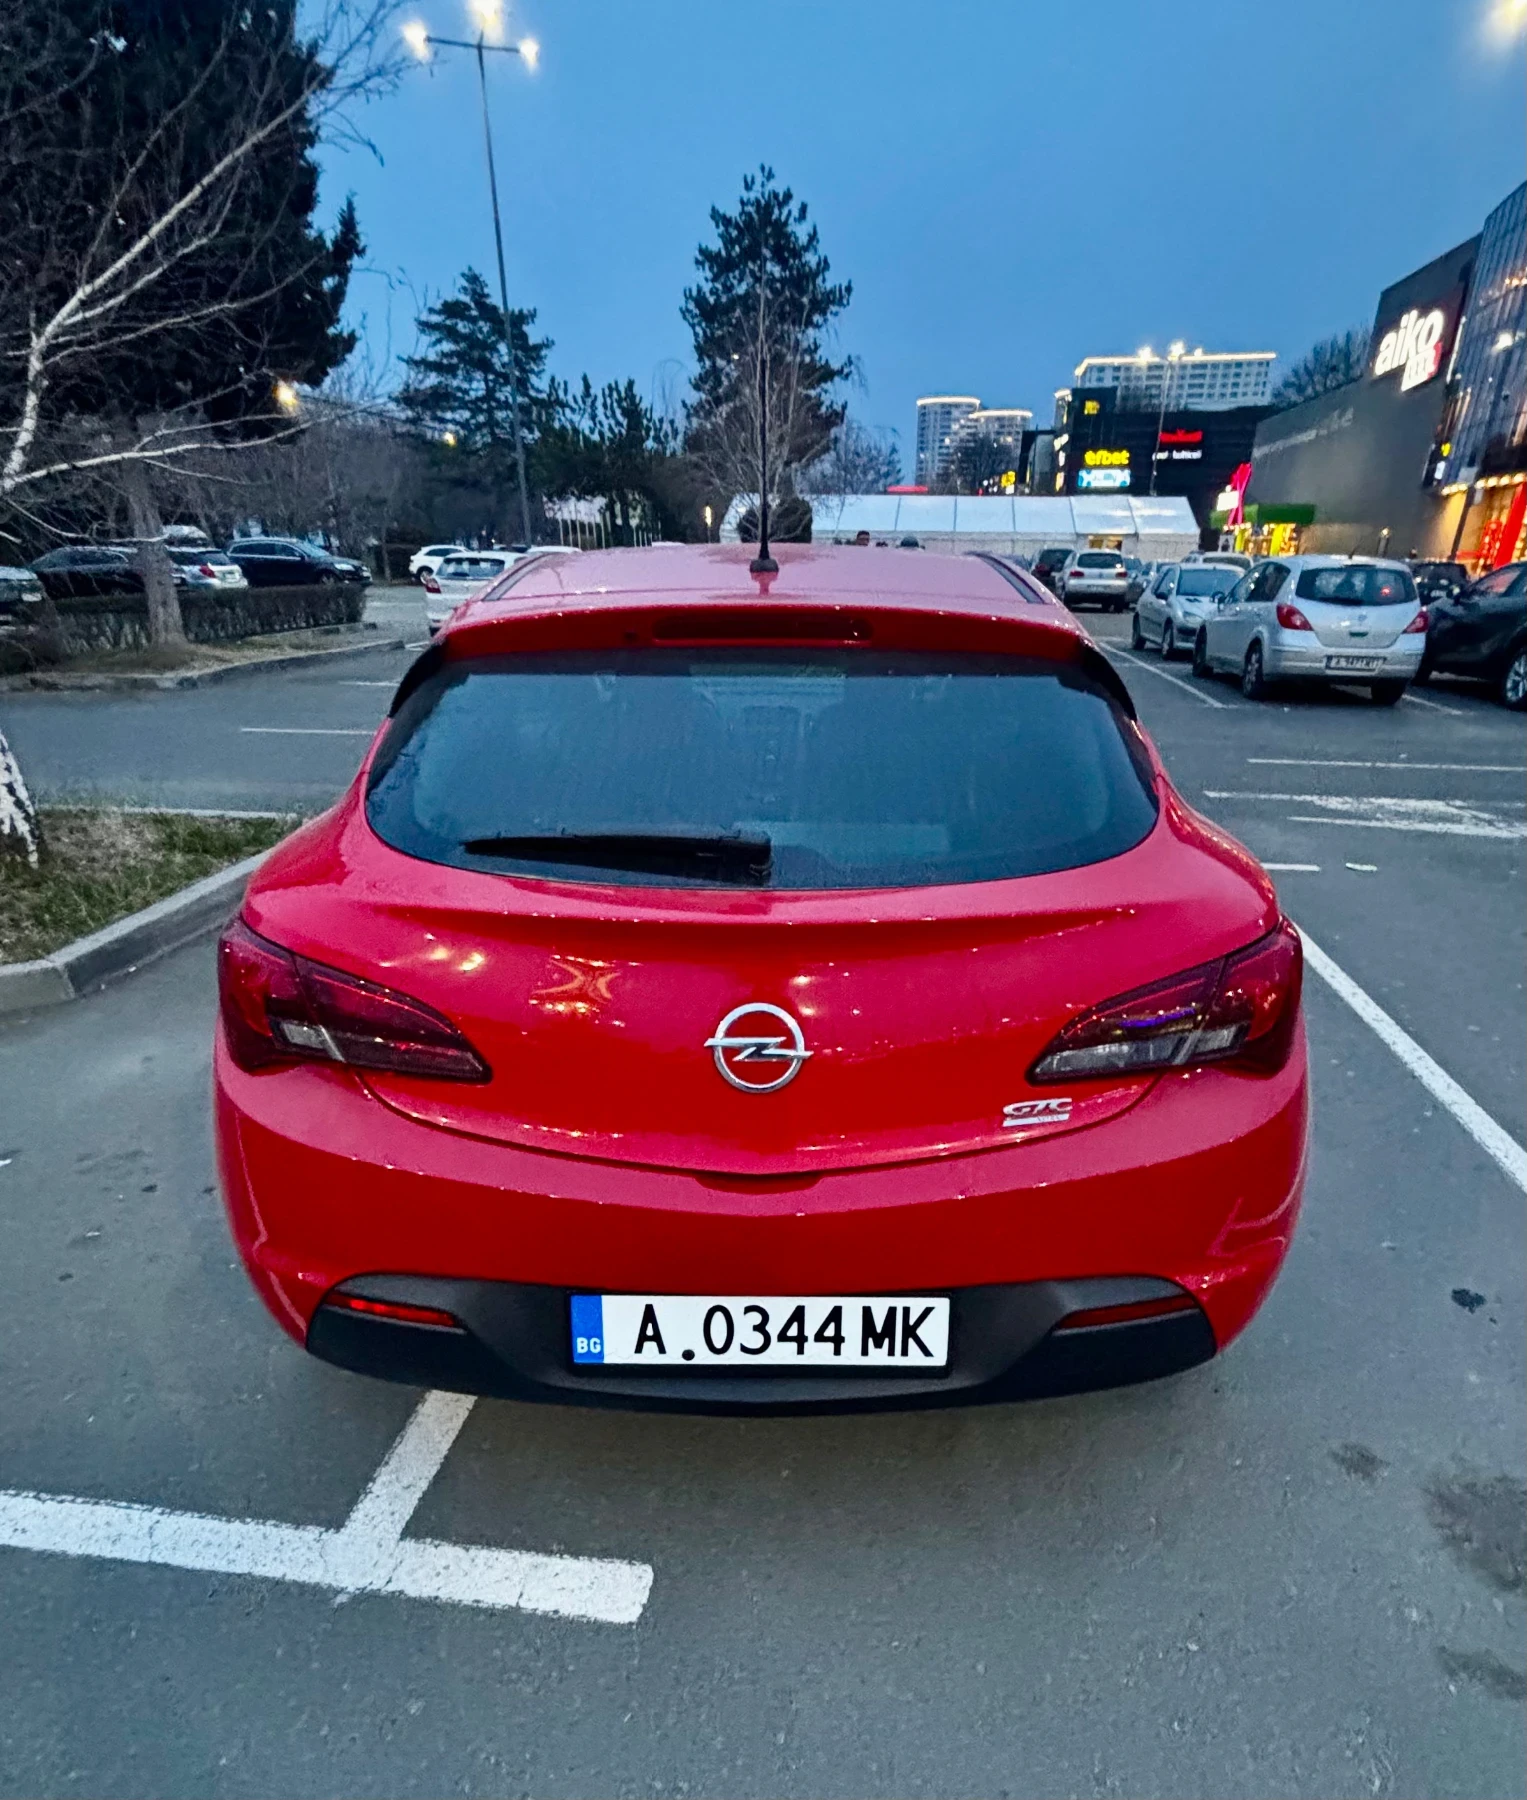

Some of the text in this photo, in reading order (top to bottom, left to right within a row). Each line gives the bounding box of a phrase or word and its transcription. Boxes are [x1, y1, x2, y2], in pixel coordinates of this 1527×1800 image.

[1374, 309, 1444, 376] aiko
[1084, 450, 1130, 466] efbet
[1003, 1098, 1073, 1115] GTC
[576, 1337, 602, 1354] BG
